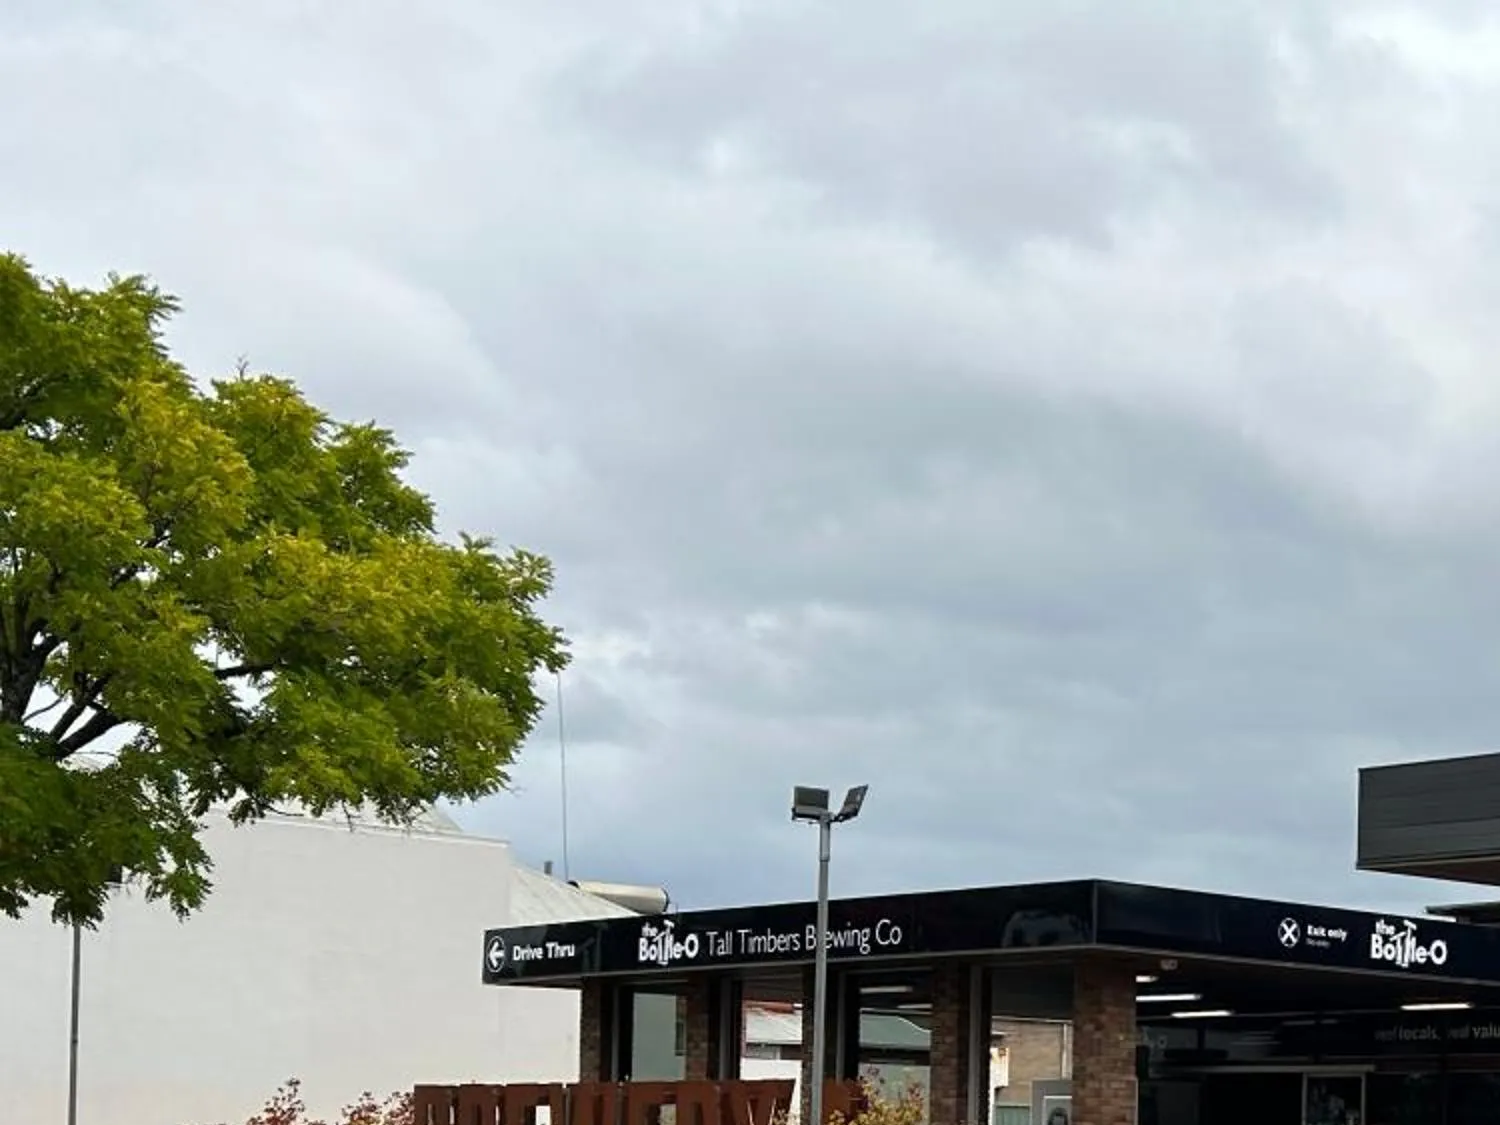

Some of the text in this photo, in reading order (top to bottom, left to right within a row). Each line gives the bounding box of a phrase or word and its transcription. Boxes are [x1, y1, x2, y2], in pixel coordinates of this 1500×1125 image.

[1375, 919, 1395, 935] the
[706, 918, 902, 956] Tall Timbers Bewing Co
[513, 942, 575, 961] Drive Thru
